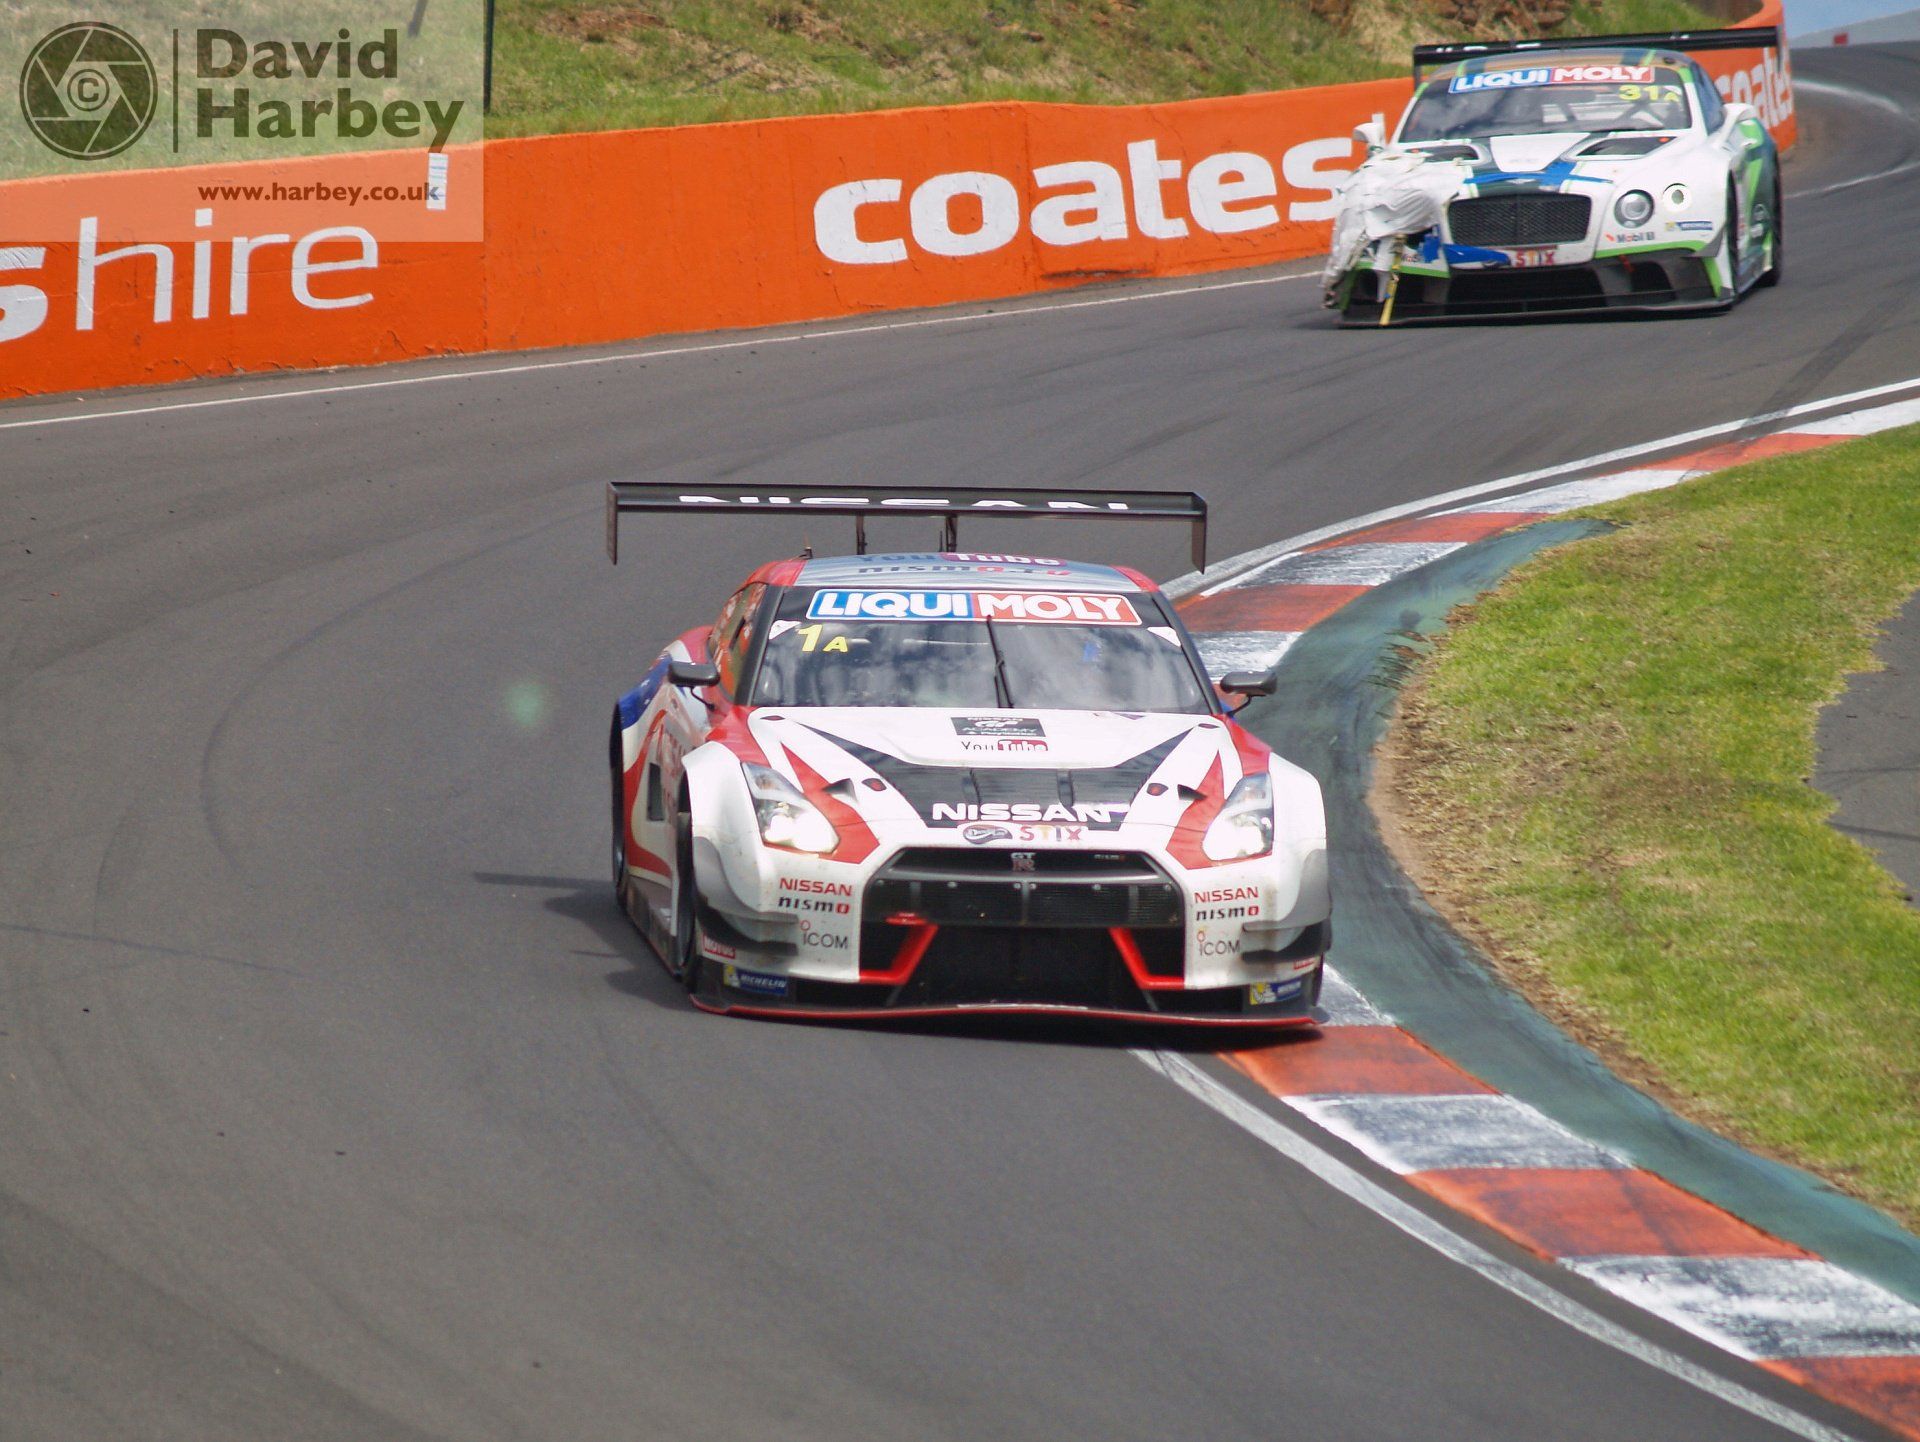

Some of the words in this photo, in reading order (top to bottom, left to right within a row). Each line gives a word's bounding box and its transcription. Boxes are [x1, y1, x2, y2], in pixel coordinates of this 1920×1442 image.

[1455, 69, 1549, 90] LIQUI
[1553, 66, 1649, 82] MOLY
[813, 138, 1353, 264] coates
[1515, 250, 1556, 267] STIX
[817, 592, 967, 618] LIQUI
[977, 594, 1124, 622] MOLY
[932, 803, 1122, 823] NISSAN
[1019, 825, 1083, 842] STIX
[779, 877, 853, 897] NISSAN
[1194, 886, 1259, 903] NISSAN
[777, 896, 851, 915] nismo
[1196, 905, 1260, 922] nismo
